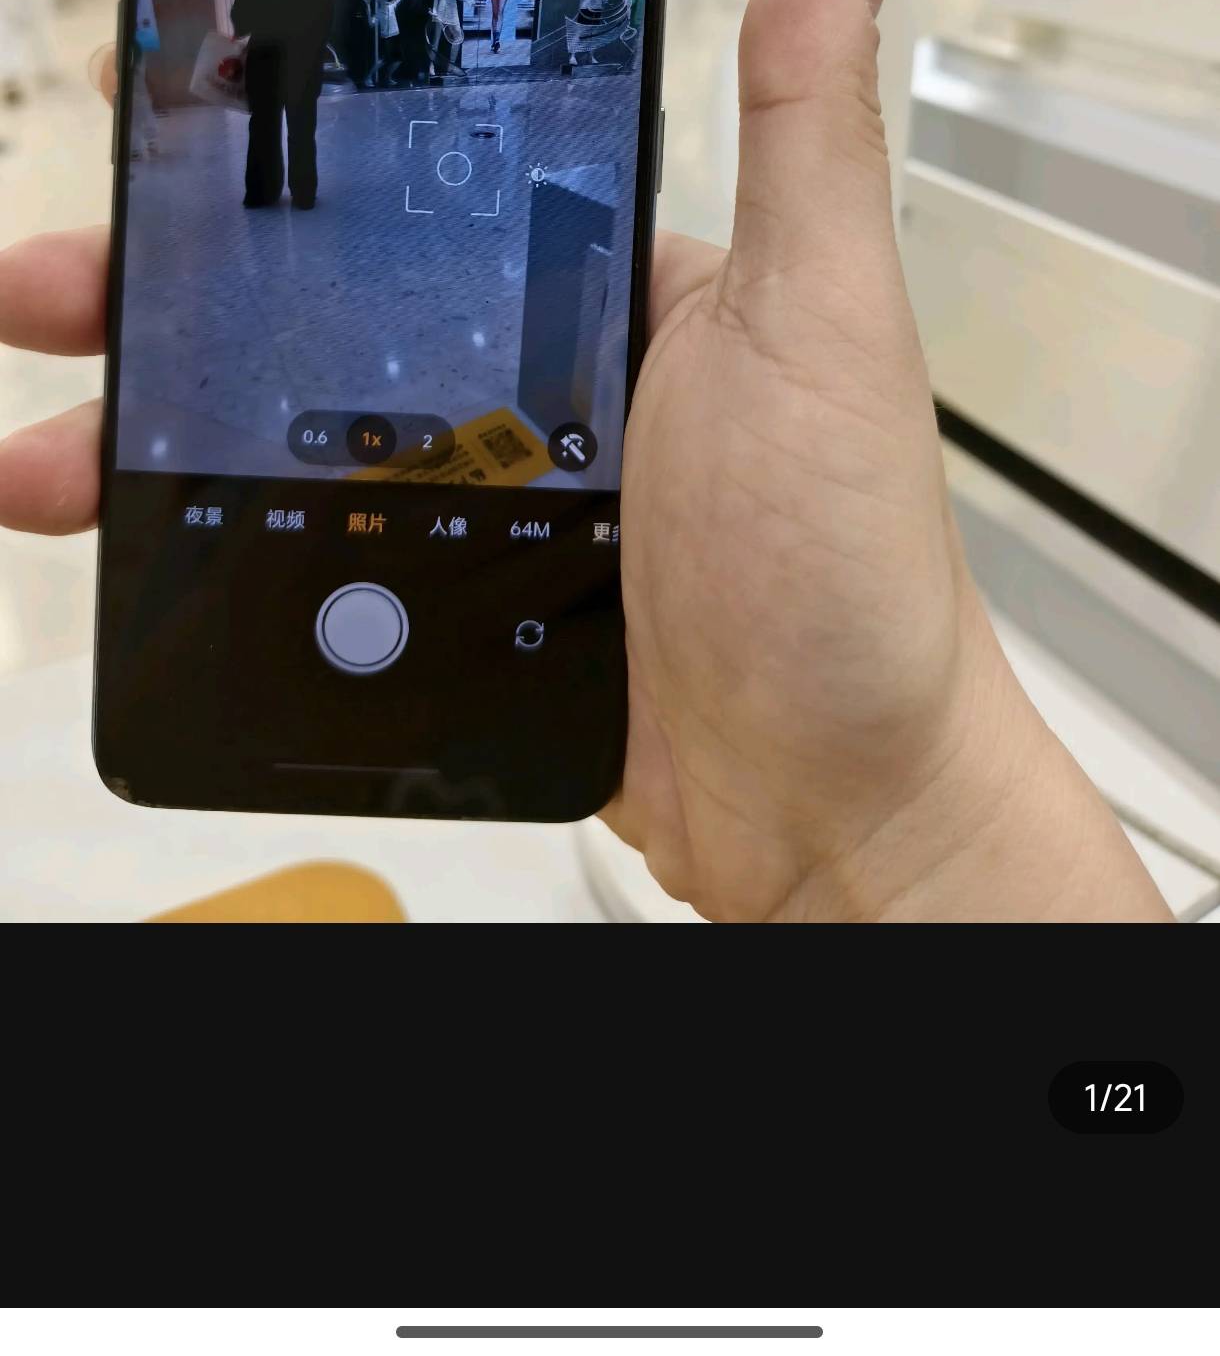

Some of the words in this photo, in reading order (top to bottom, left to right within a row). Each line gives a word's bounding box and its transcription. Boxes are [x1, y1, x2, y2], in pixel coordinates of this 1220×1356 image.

[303, 429, 328, 445] 0.6
[362, 431, 381, 446] 1x
[423, 434, 433, 448] 2
[184, 505, 224, 527] 夜景
[266, 509, 305, 530] 视频
[348, 512, 386, 533] 照片
[429, 515, 467, 537] 人像
[510, 521, 550, 538] 64M
[1085, 1083, 1145, 1112] 1/21
